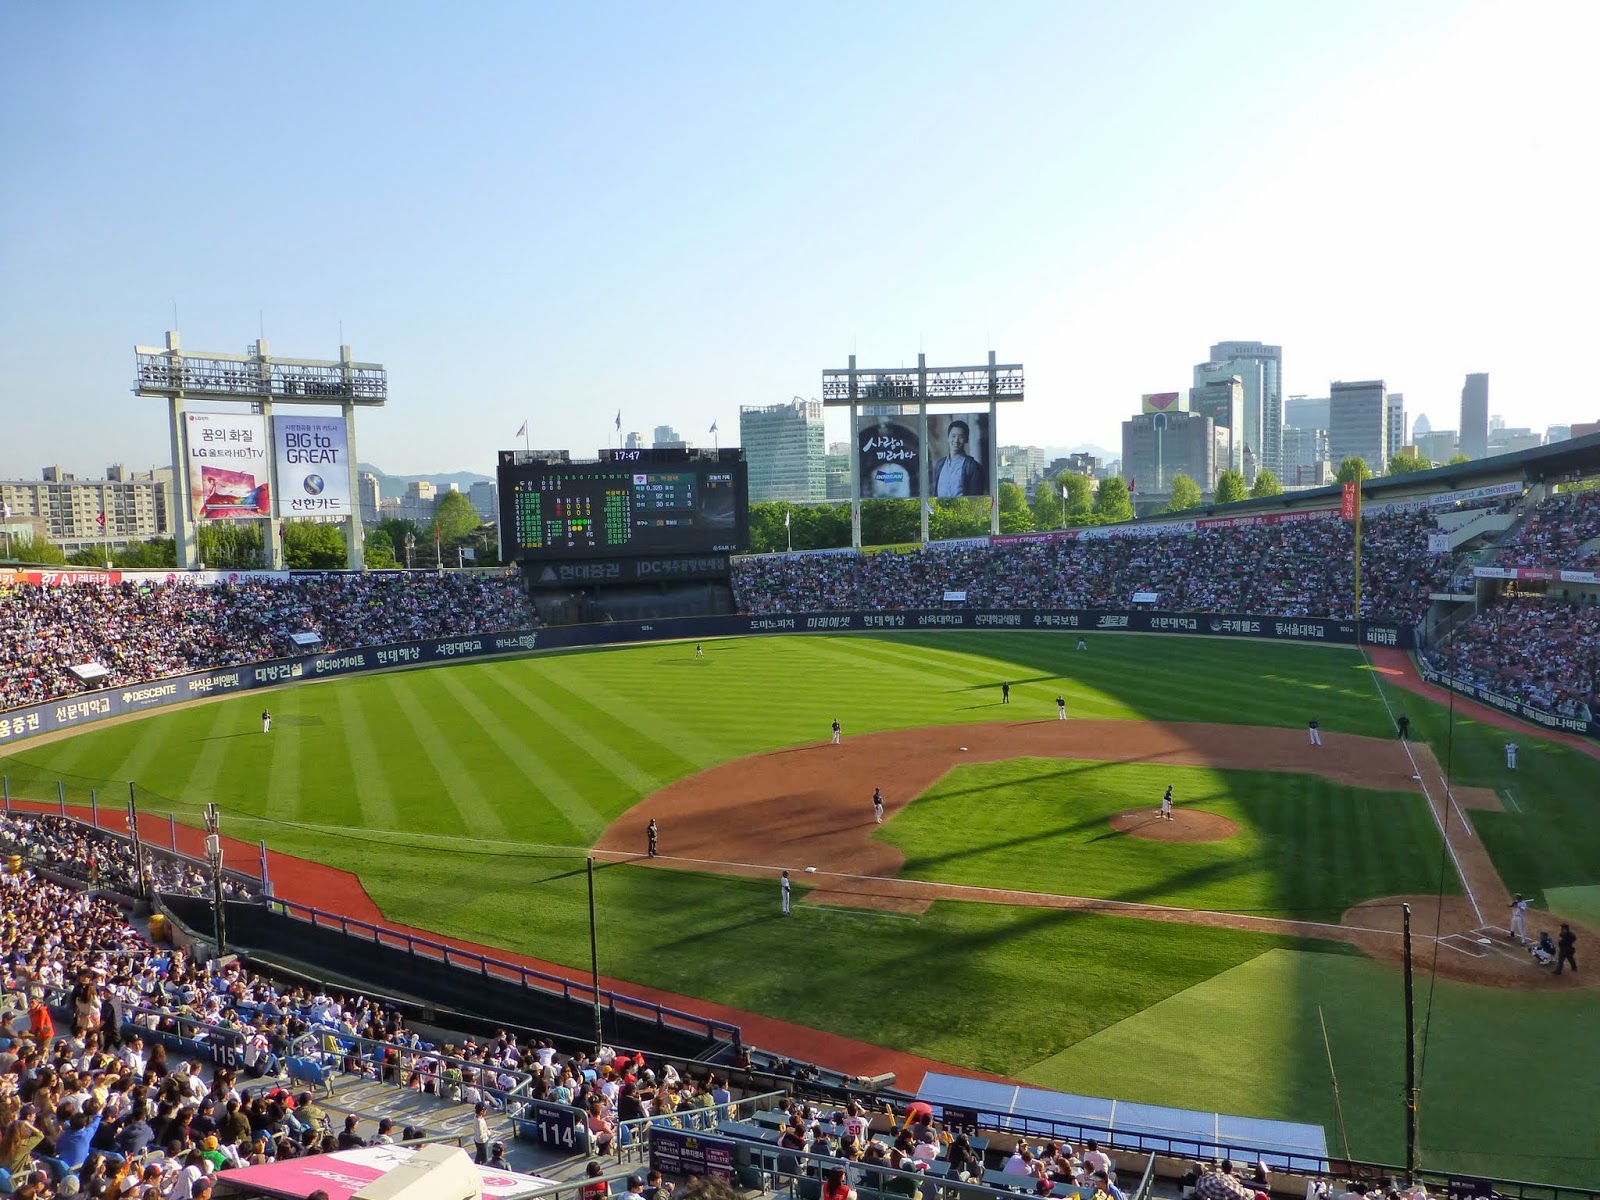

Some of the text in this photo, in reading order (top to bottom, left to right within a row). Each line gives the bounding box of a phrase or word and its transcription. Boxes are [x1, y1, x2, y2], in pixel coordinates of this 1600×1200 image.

[202, 429, 252, 442] 꿈의 화질
[286, 433, 331, 448] BIG to
[863, 436, 903, 452] 사람이
[192, 449, 207, 457] LG
[287, 449, 339, 464] GREAT
[615, 451, 640, 460] 17:47
[876, 450, 916, 461] 미래다
[291, 499, 340, 510] 신한카드
[560, 563, 619, 580] 현대증권
[750, 619, 795, 629] 도미노피자
[807, 617, 850, 628] 미래에셋
[864, 615, 905, 626] 현대해상
[918, 615, 963, 624] 삼육대학교
[1033, 615, 1078, 625] 우체국보험
[1150, 618, 1197, 629] 선문대학교
[1276, 623, 1324, 637] 동서울대학교
[1367, 632, 1397, 645] 비비큐
[436, 640, 482, 656] 서경대학교
[377, 647, 420, 664] 현대해상
[316, 654, 365, 673] 인디아게이트
[255, 662, 303, 681] 대방건설
[132, 684, 176, 701] DESCENTE
[56, 698, 110, 722] 선문대학교
[1556, 718, 1587, 732] 나비엔
[211, 1044, 235, 1066] 115
[539, 1122, 573, 1148] 114
[849, 1126, 861, 1134] 50
